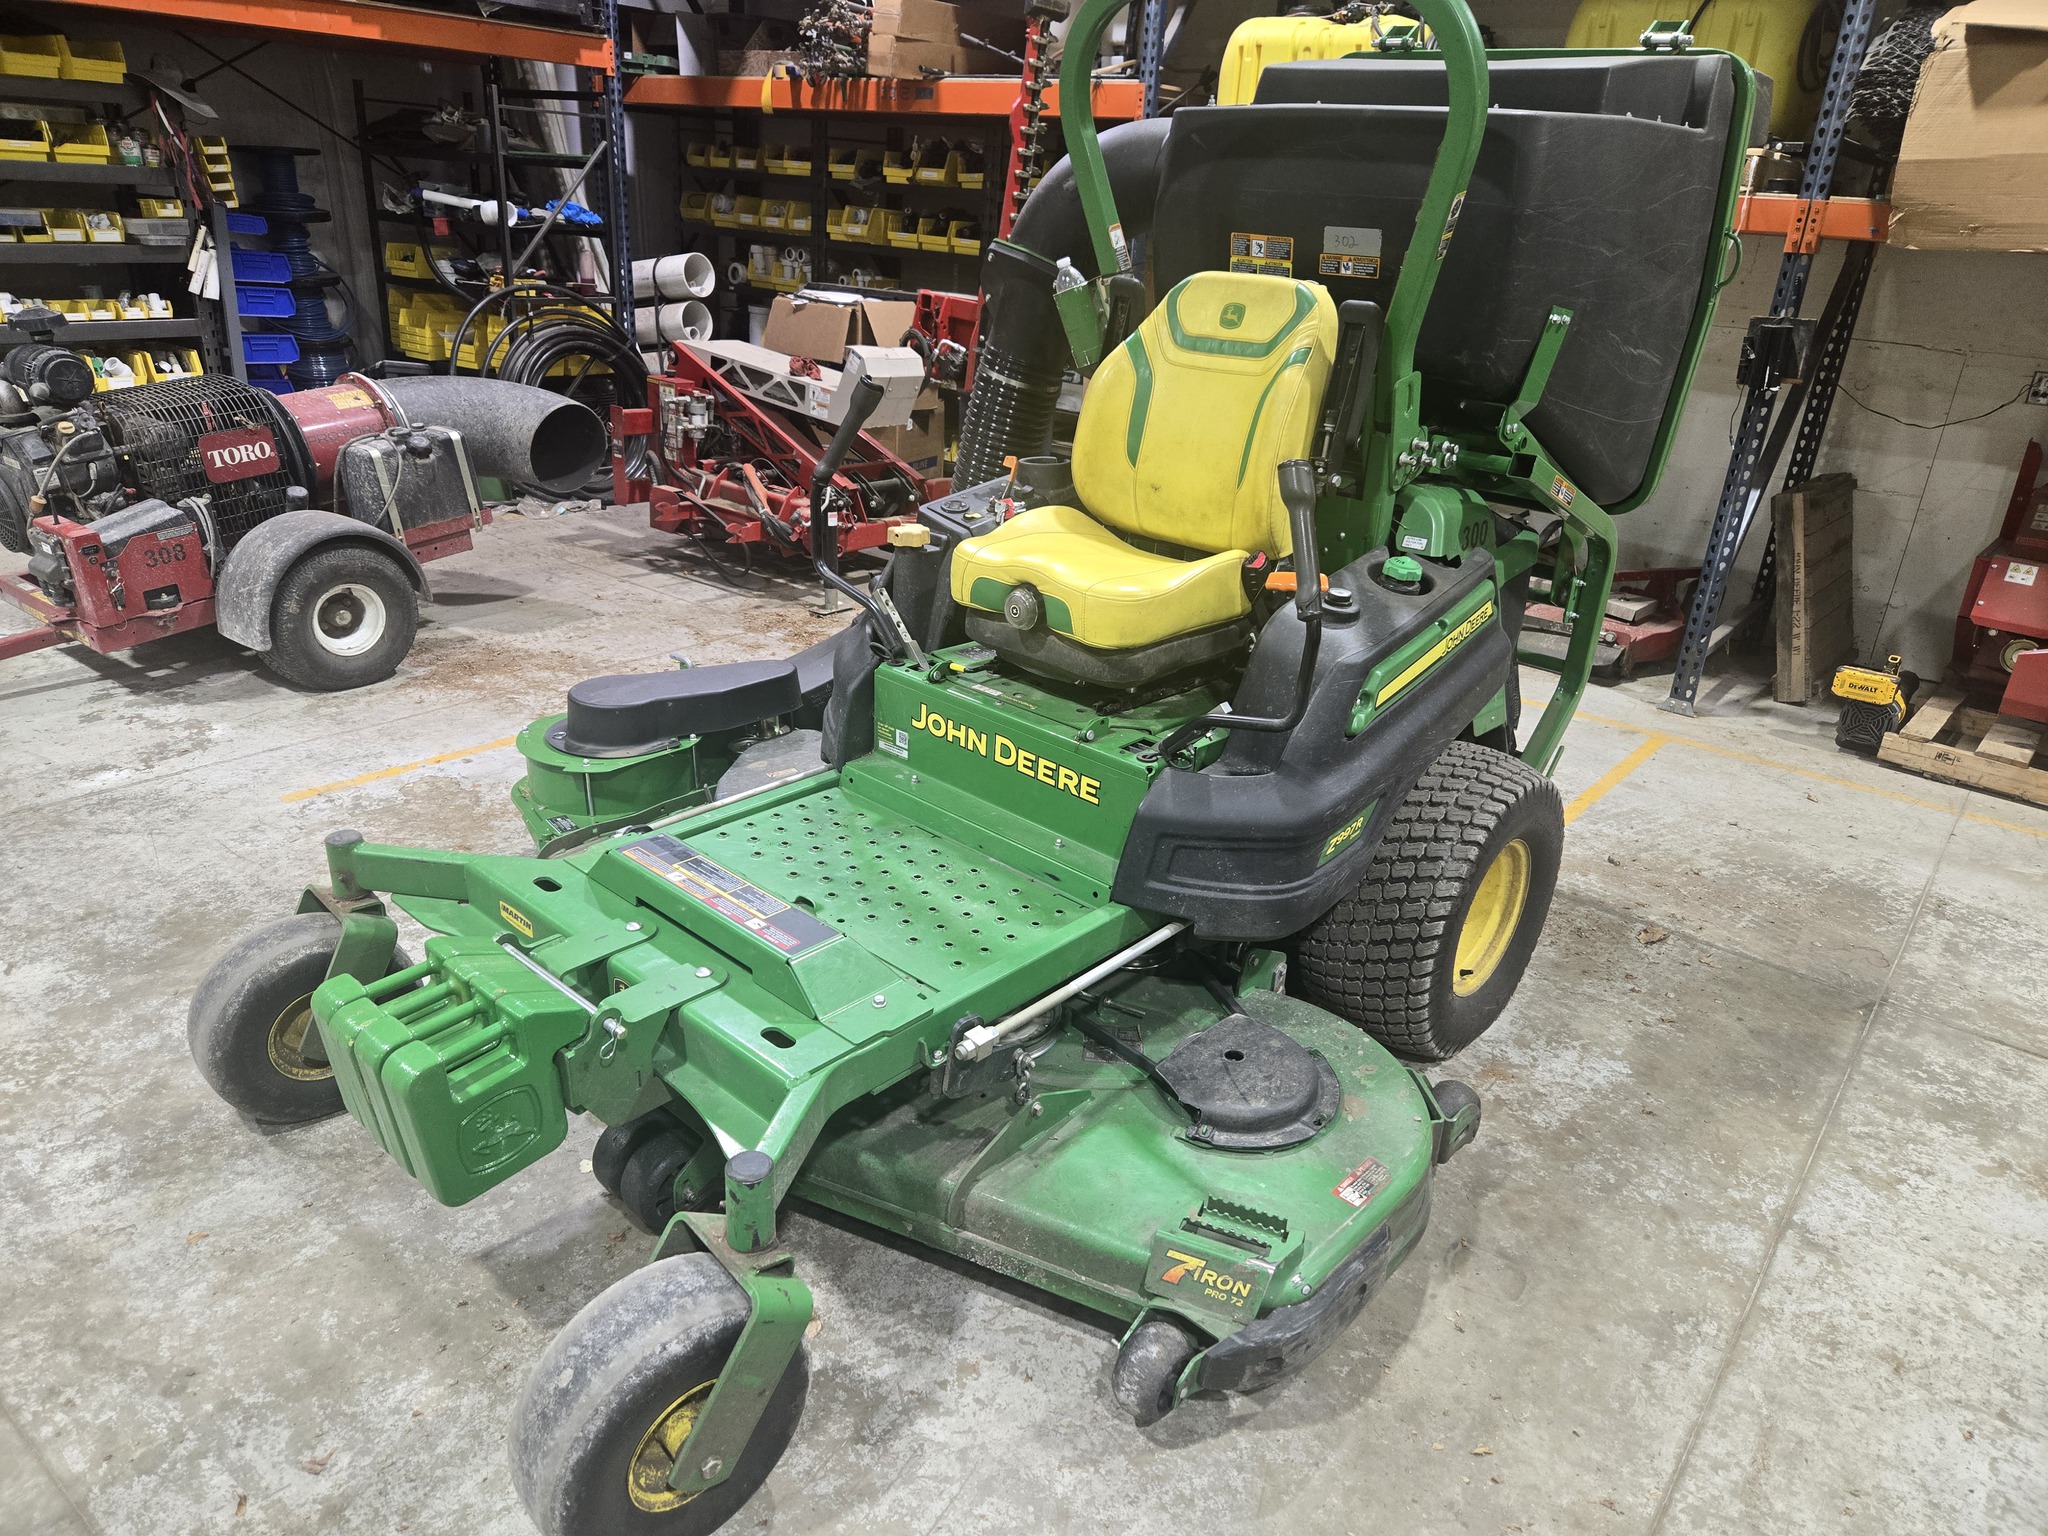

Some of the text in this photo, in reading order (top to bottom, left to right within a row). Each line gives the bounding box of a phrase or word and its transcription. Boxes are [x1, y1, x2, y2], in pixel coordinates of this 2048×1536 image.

[1334, 234, 1360, 248] 302
[306, 421, 388, 445] PRO FORCE
[207, 441, 271, 469] TORO
[1462, 520, 1488, 552] 300
[143, 543, 187, 568] 308
[1440, 608, 1490, 657] JOHN DEERE
[911, 702, 1101, 807] JOHN DEERE
[1326, 816, 1364, 855] Z997R
[502, 903, 532, 930] MARTIN
[1204, 1287, 1244, 1308] PRO 72
